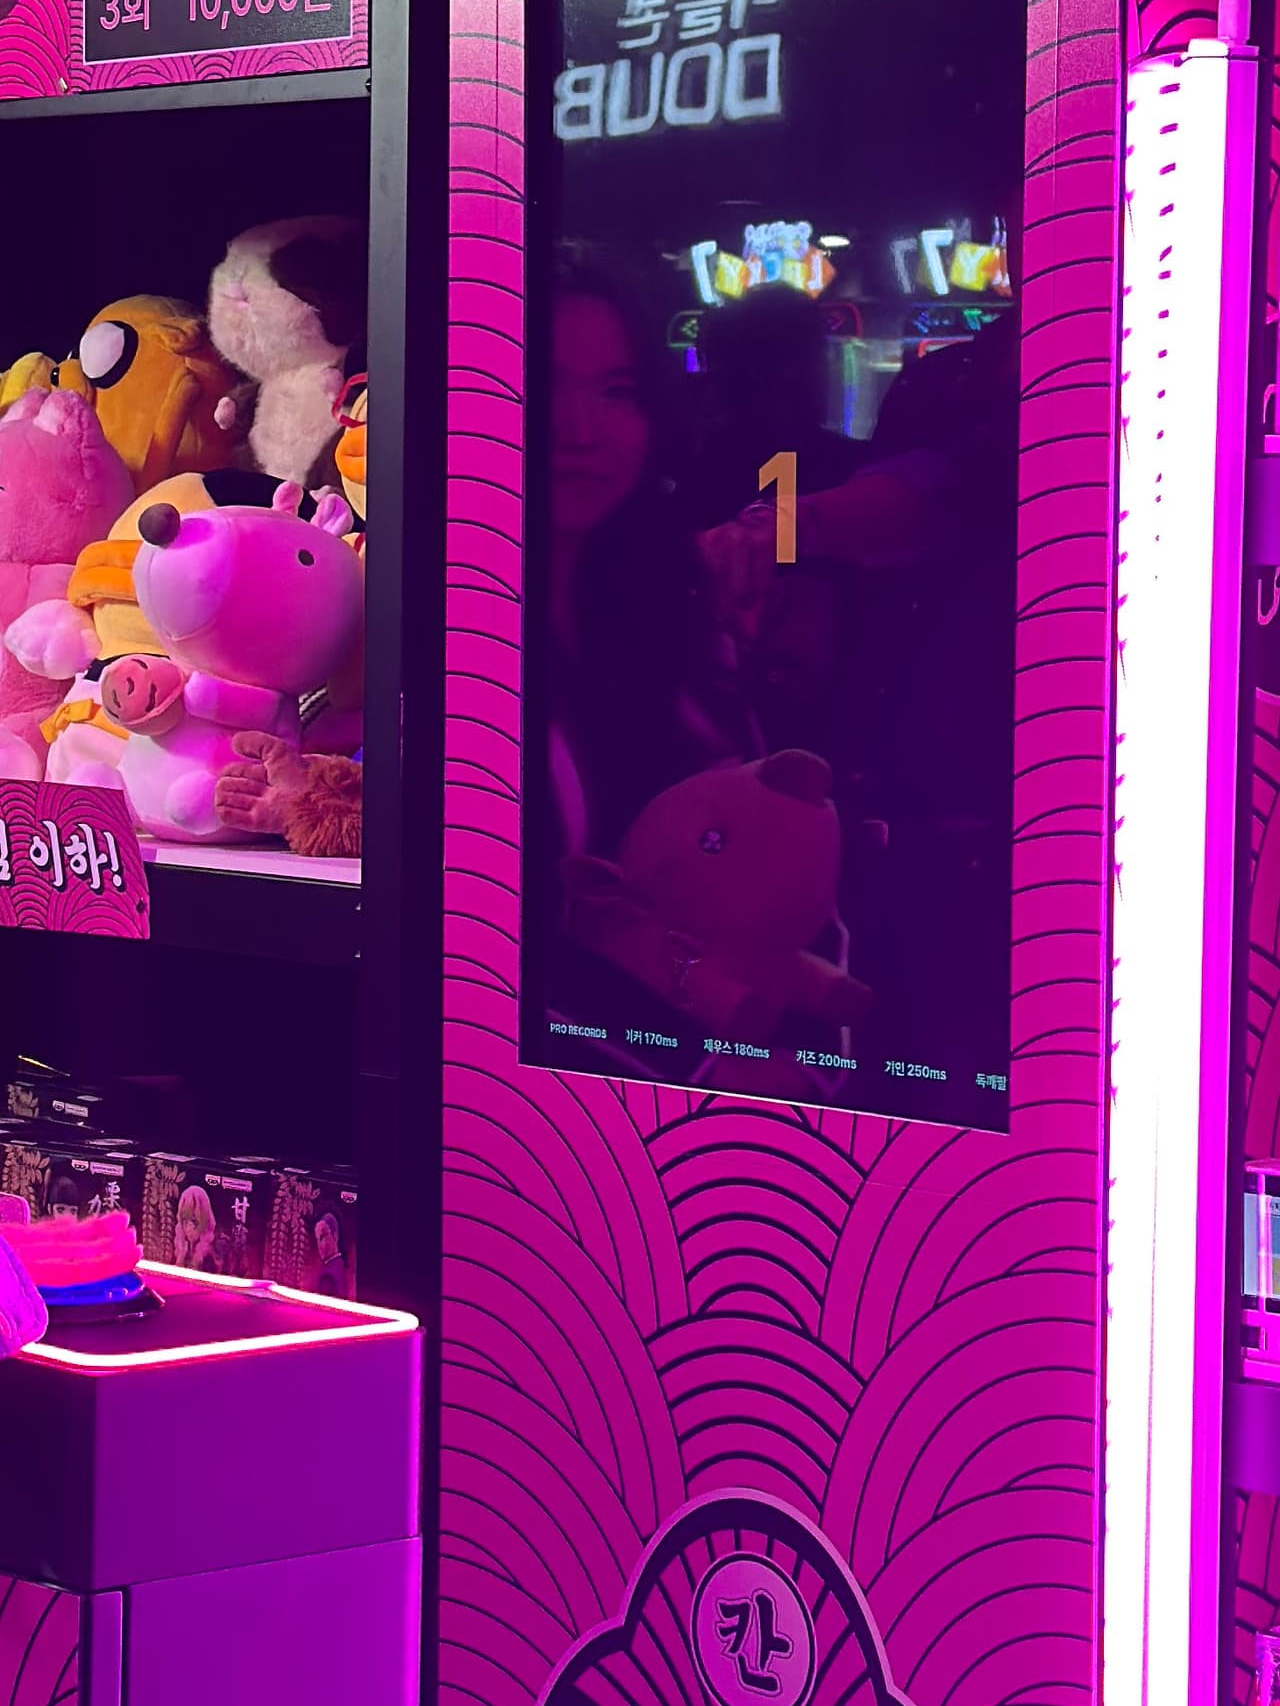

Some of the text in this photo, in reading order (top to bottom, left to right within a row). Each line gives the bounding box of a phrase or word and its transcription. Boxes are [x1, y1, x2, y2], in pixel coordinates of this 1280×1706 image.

[757, 450, 798, 564] 1
[29, 822, 123, 890] 이하!
[549, 1022, 567, 1035] PRO
[568, 1024, 608, 1039] RECORDS
[644, 1032, 678, 1048] 170ms
[703, 1038, 733, 1054] 제우스
[734, 1042, 770, 1059] 180ms
[818, 1053, 858, 1070] 200ms
[884, 1060, 906, 1077] 기인
[907, 1063, 948, 1081] 250ms
